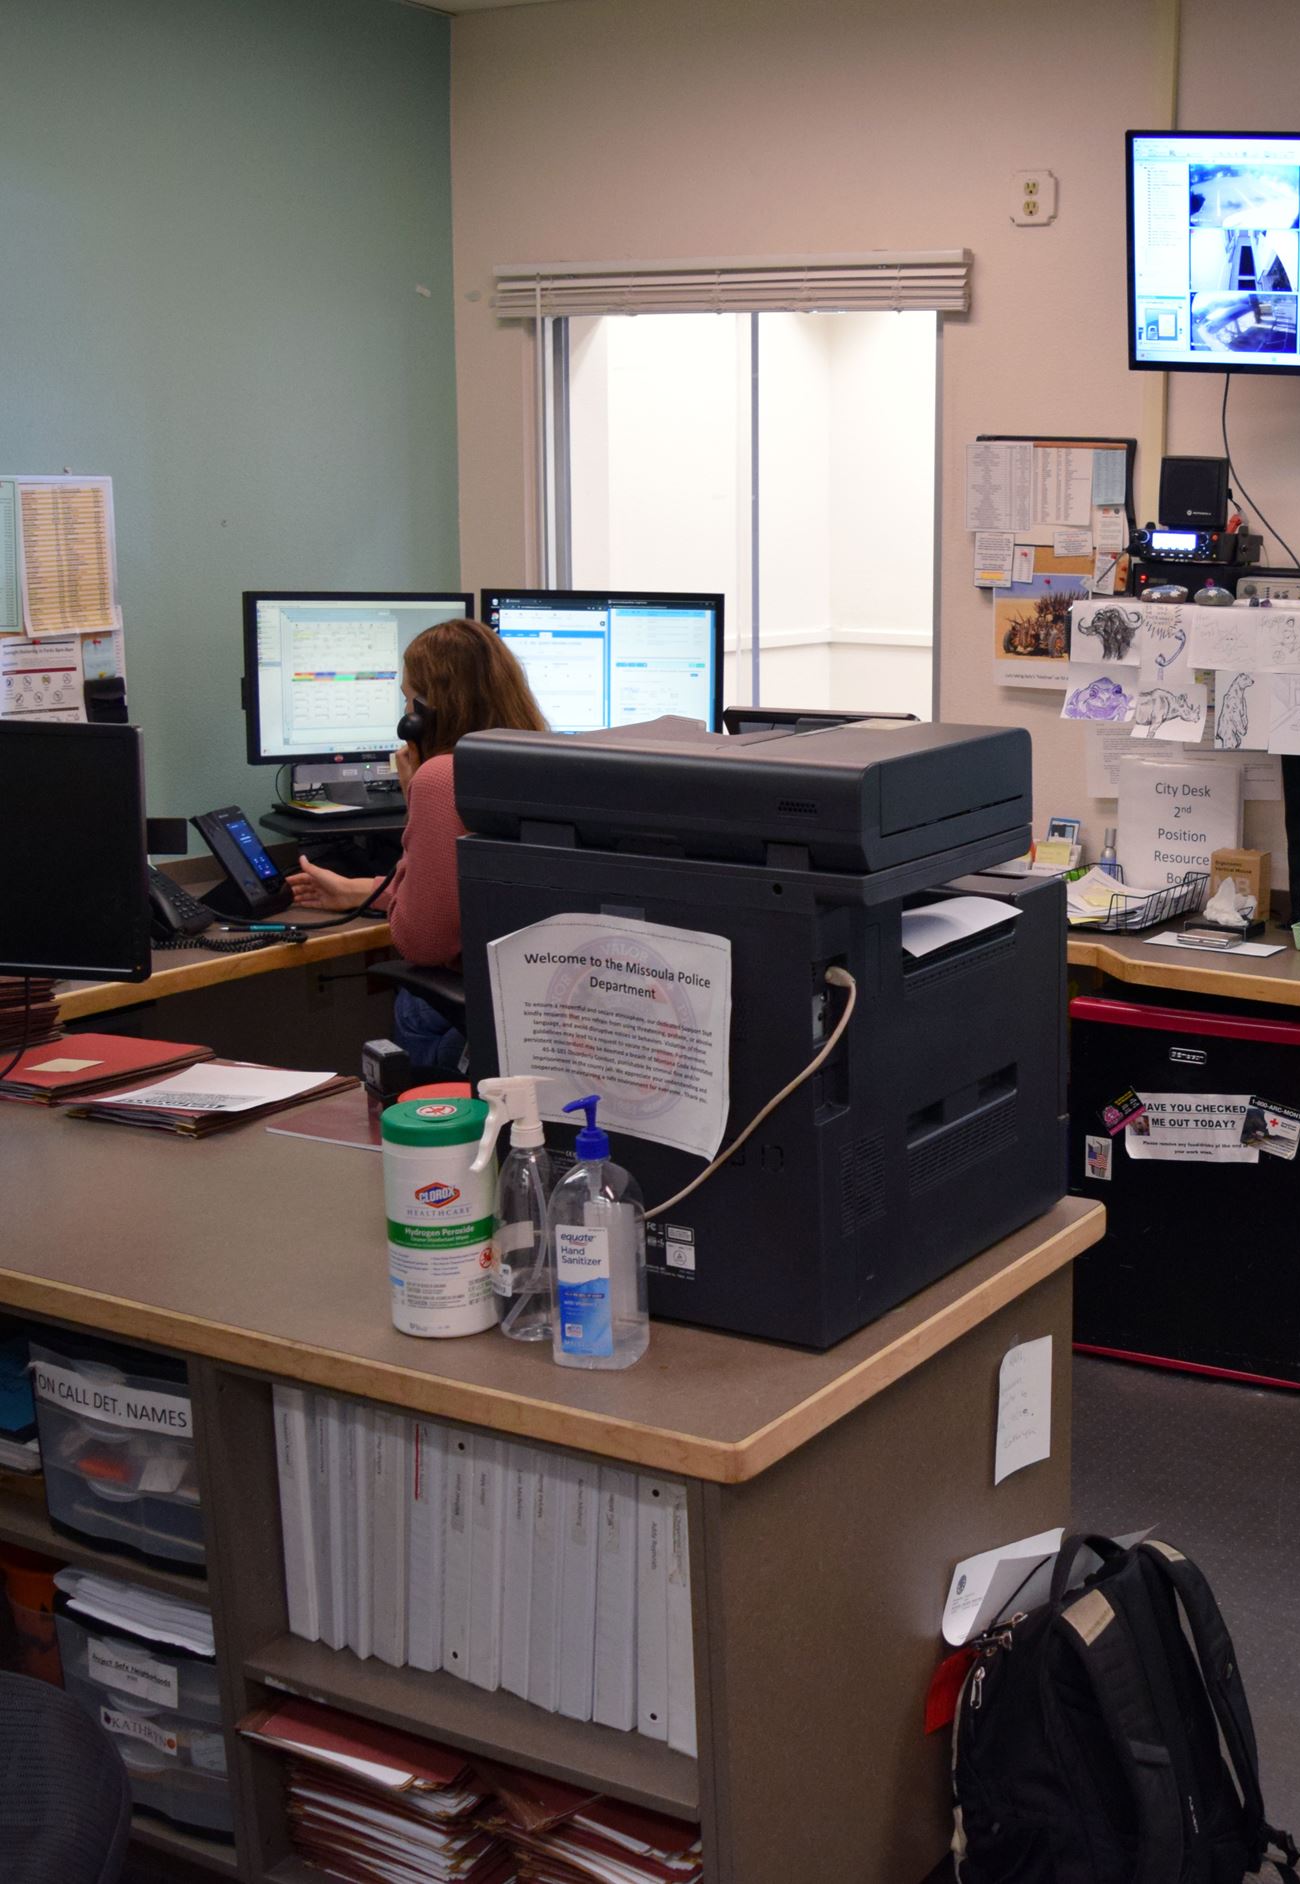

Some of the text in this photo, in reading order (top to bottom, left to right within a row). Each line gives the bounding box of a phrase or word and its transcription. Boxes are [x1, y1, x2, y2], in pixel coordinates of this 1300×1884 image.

[1155, 782, 1211, 798] City Desk
[1173, 806, 1192, 818] 2nd
[1158, 828, 1206, 843] Position
[1154, 850, 1210, 866] Resource
[524, 952, 711, 989] Welcome to the Missoula Police
[590, 976, 656, 1000] Department
[1170, 1103, 1192, 1112] YOU
[1195, 1104, 1247, 1113] CHECKED
[1151, 1118, 1236, 1128] ME OUT TODAY?
[419, 1187, 456, 1202] CLOROX
[406, 1207, 471, 1217] HEALTHCARE
[405, 1225, 474, 1238] Hydrogen Peroxide
[561, 1232, 594, 1243] equate
[561, 1246, 585, 1255] Hand
[562, 1256, 602, 1266] Sanitizer
[38, 1374, 187, 1428] ON CALL DET. NAMES
